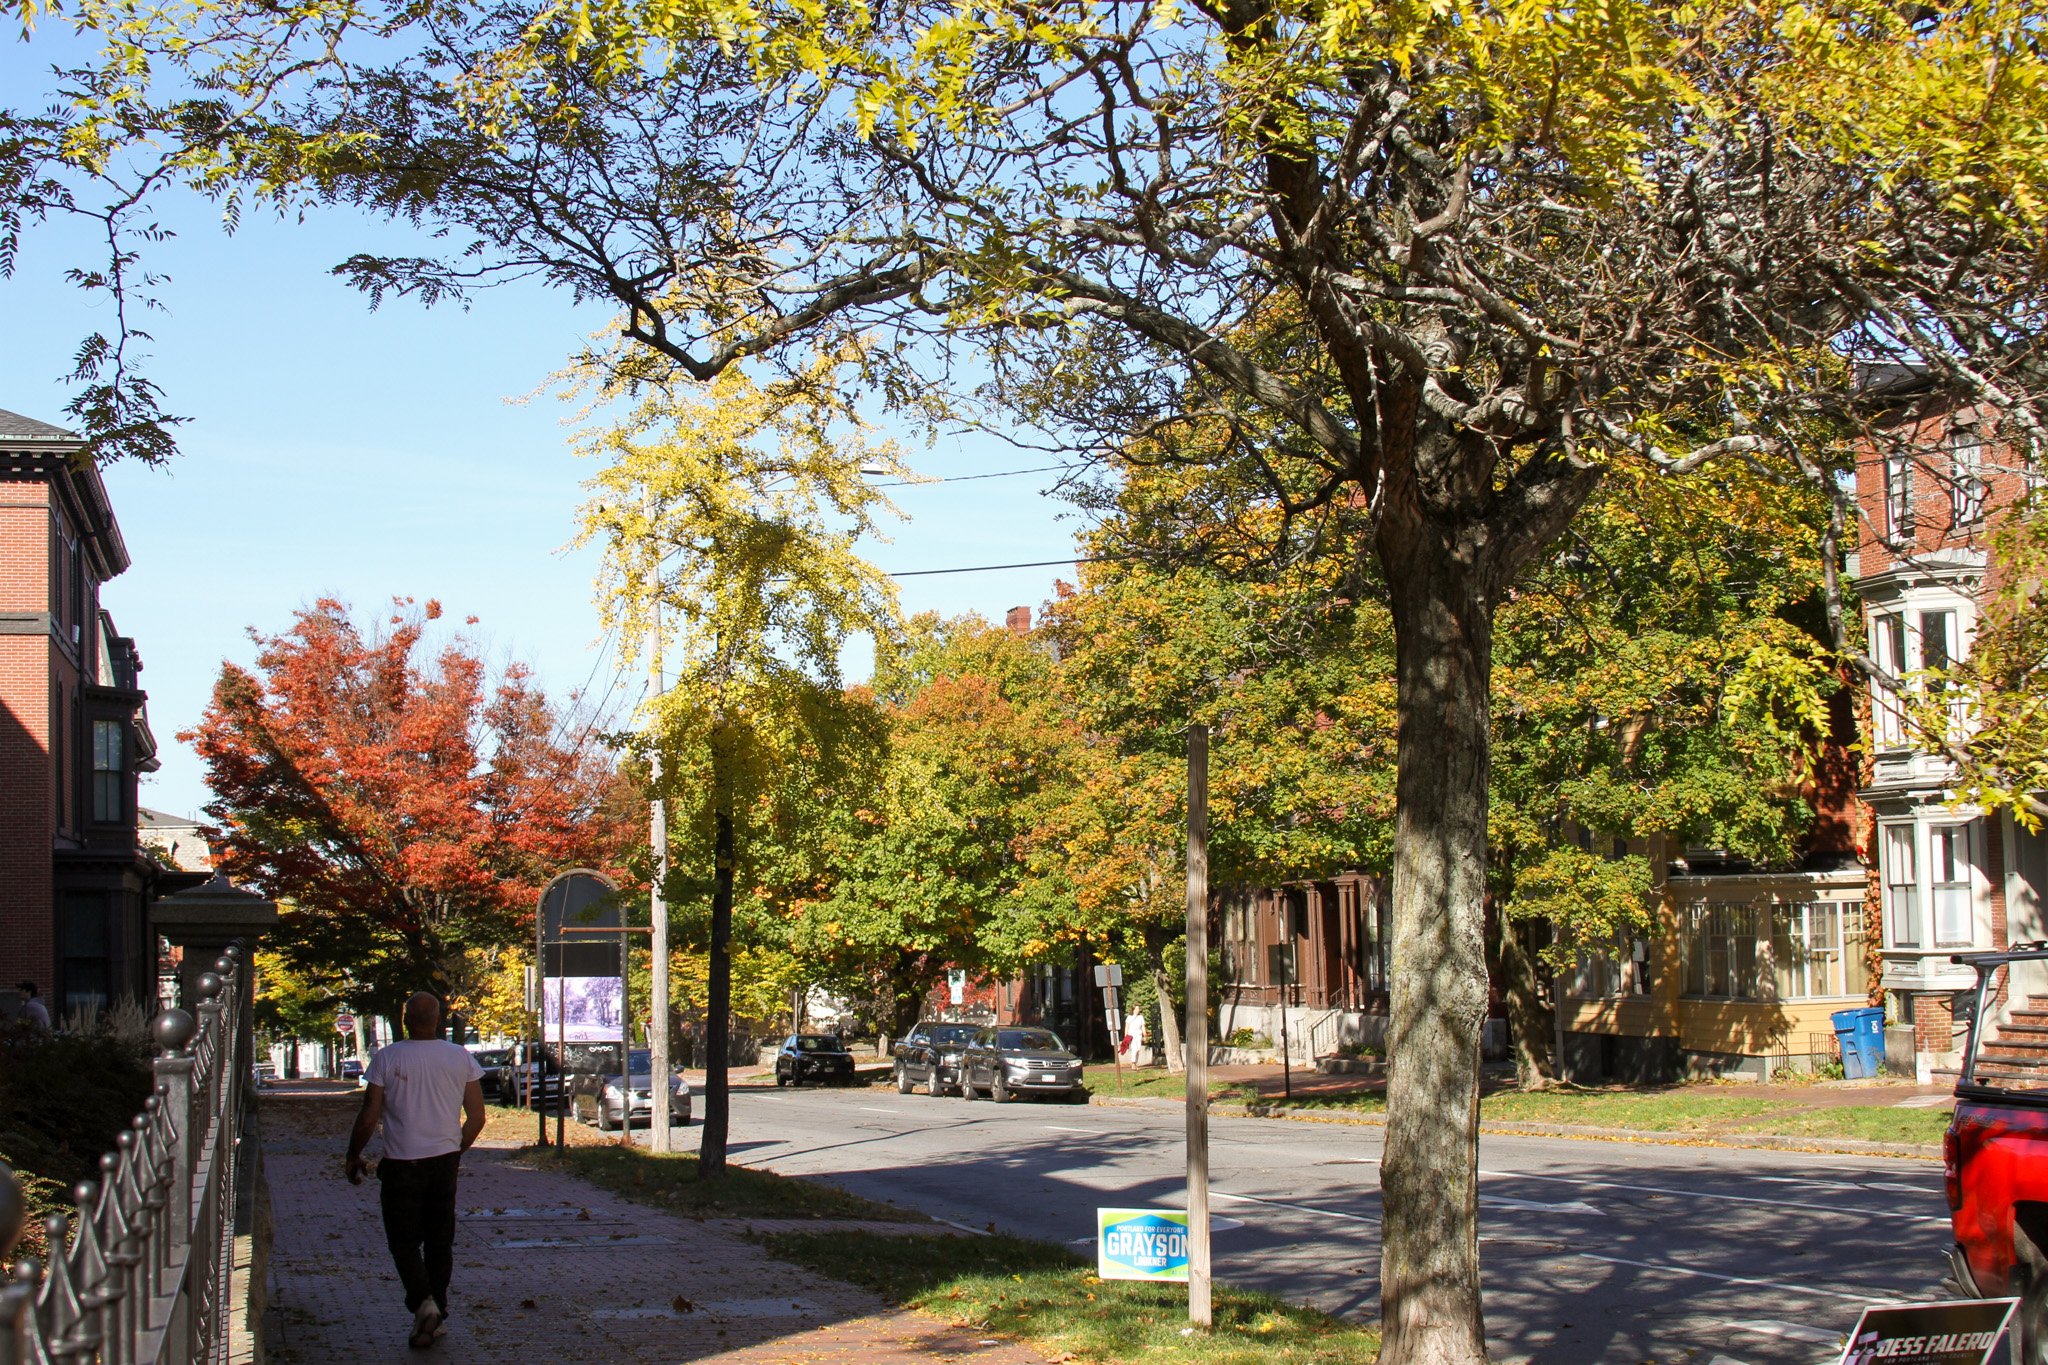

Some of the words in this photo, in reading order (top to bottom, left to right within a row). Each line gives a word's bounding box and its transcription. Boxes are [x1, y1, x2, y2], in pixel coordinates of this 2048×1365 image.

[1116, 1225, 1144, 1233] PORTLAND
[1156, 1226, 1184, 1234] EVERYONE
[1107, 1232, 1188, 1257] GRAYSON
[1134, 1256, 1167, 1267] LOOKNER
[1924, 1331, 1995, 1354] FALERO
